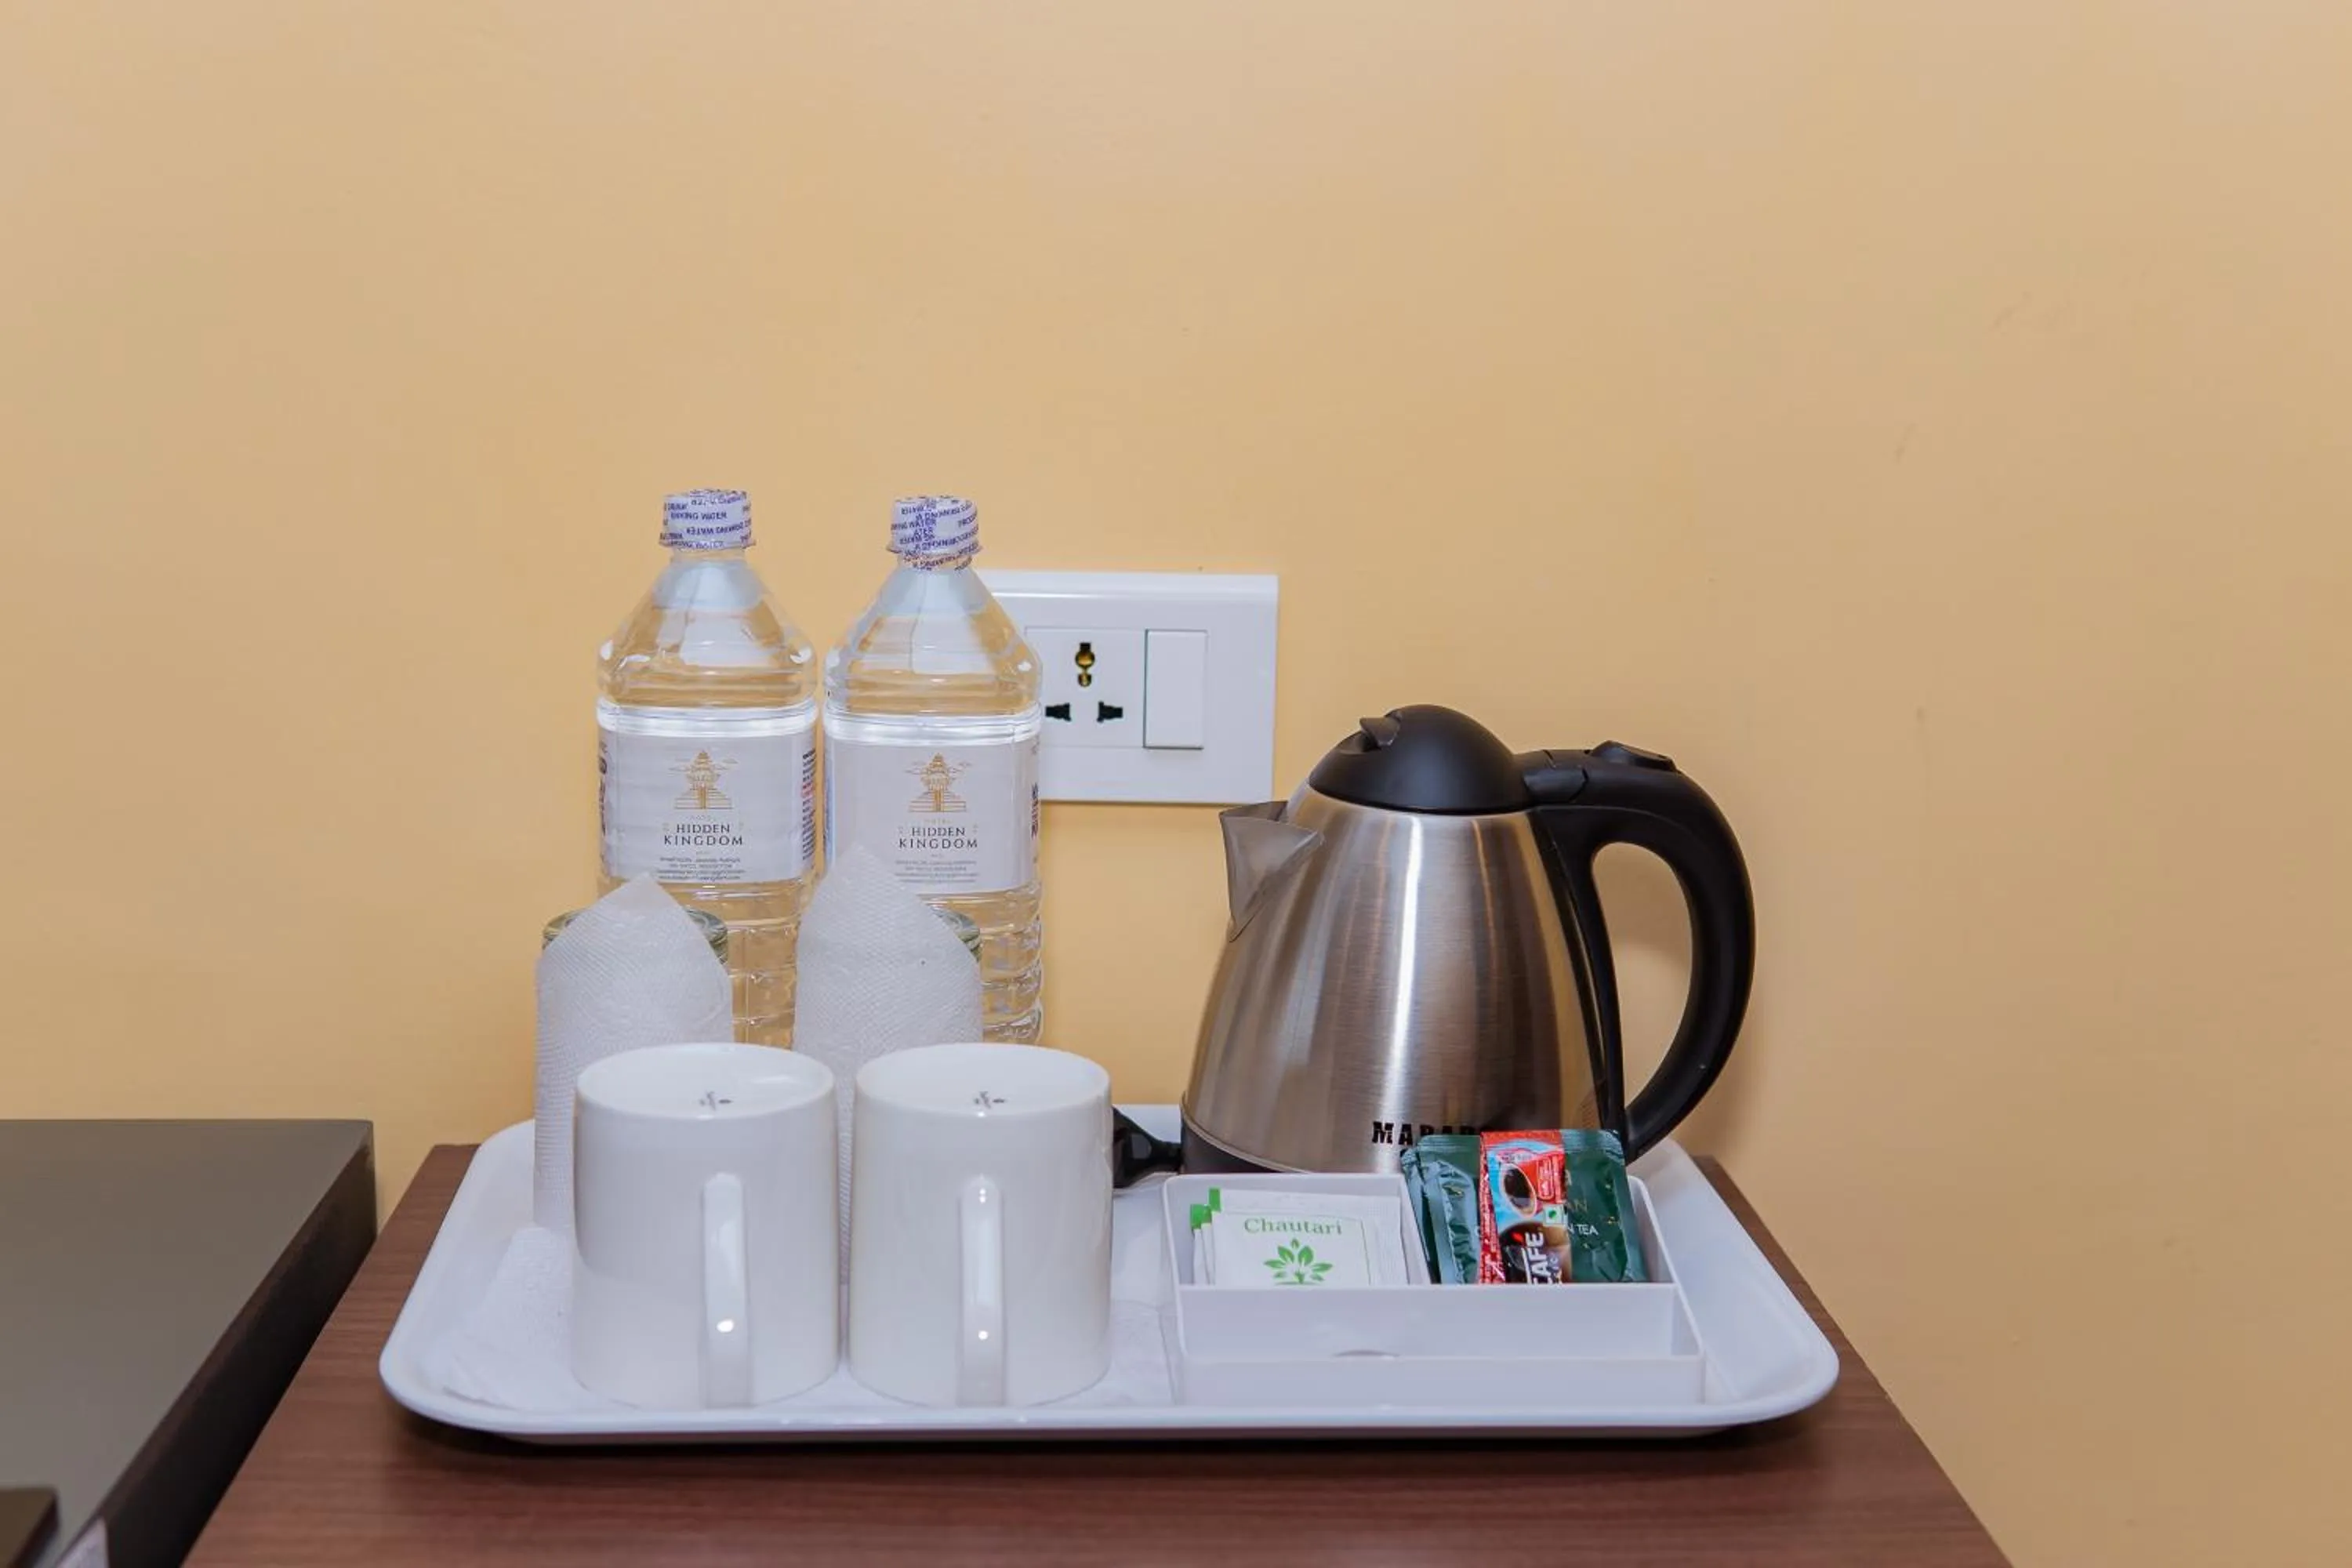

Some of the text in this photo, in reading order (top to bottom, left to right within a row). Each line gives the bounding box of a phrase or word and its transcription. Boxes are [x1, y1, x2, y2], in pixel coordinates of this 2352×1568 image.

[677, 824, 730, 833] HIDDEN
[912, 827, 965, 837] HIDDEN
[664, 835, 743, 846] KINGDOM
[899, 838, 978, 849] KINGDOM
[1243, 1218, 1343, 1236] Chautari
[1575, 1224, 1599, 1236] TEA
